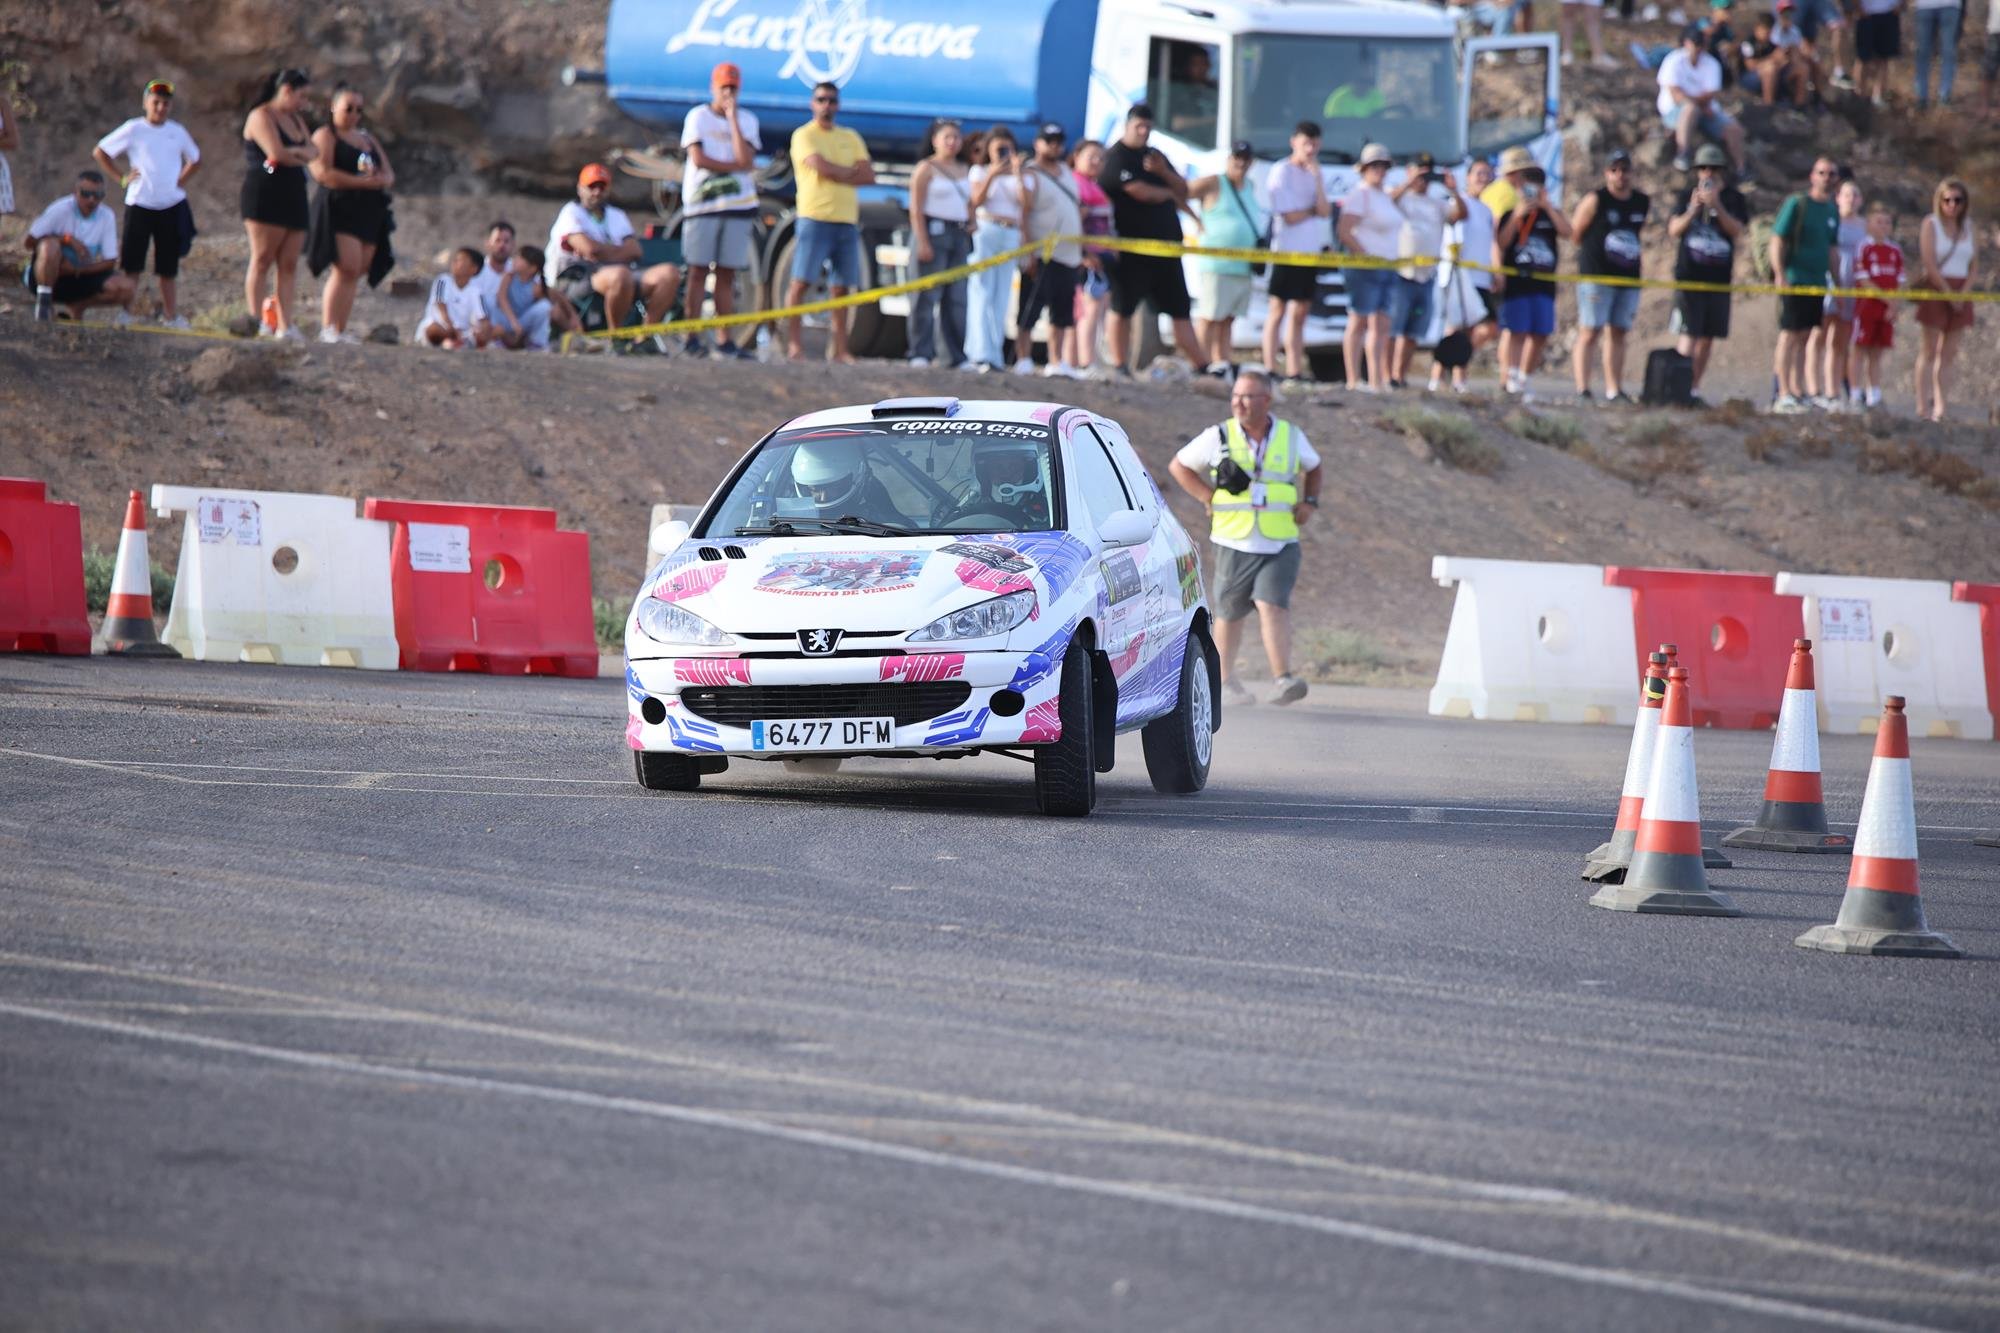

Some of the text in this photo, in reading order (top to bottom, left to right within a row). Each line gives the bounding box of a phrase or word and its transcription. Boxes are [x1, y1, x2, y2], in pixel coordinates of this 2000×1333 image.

[891, 421, 1049, 438] CODIGO CERO
[753, 585, 839, 597] CAMPAMENTO
[863, 583, 915, 594] VERANO
[769, 721, 890, 746] 6477 DFM
